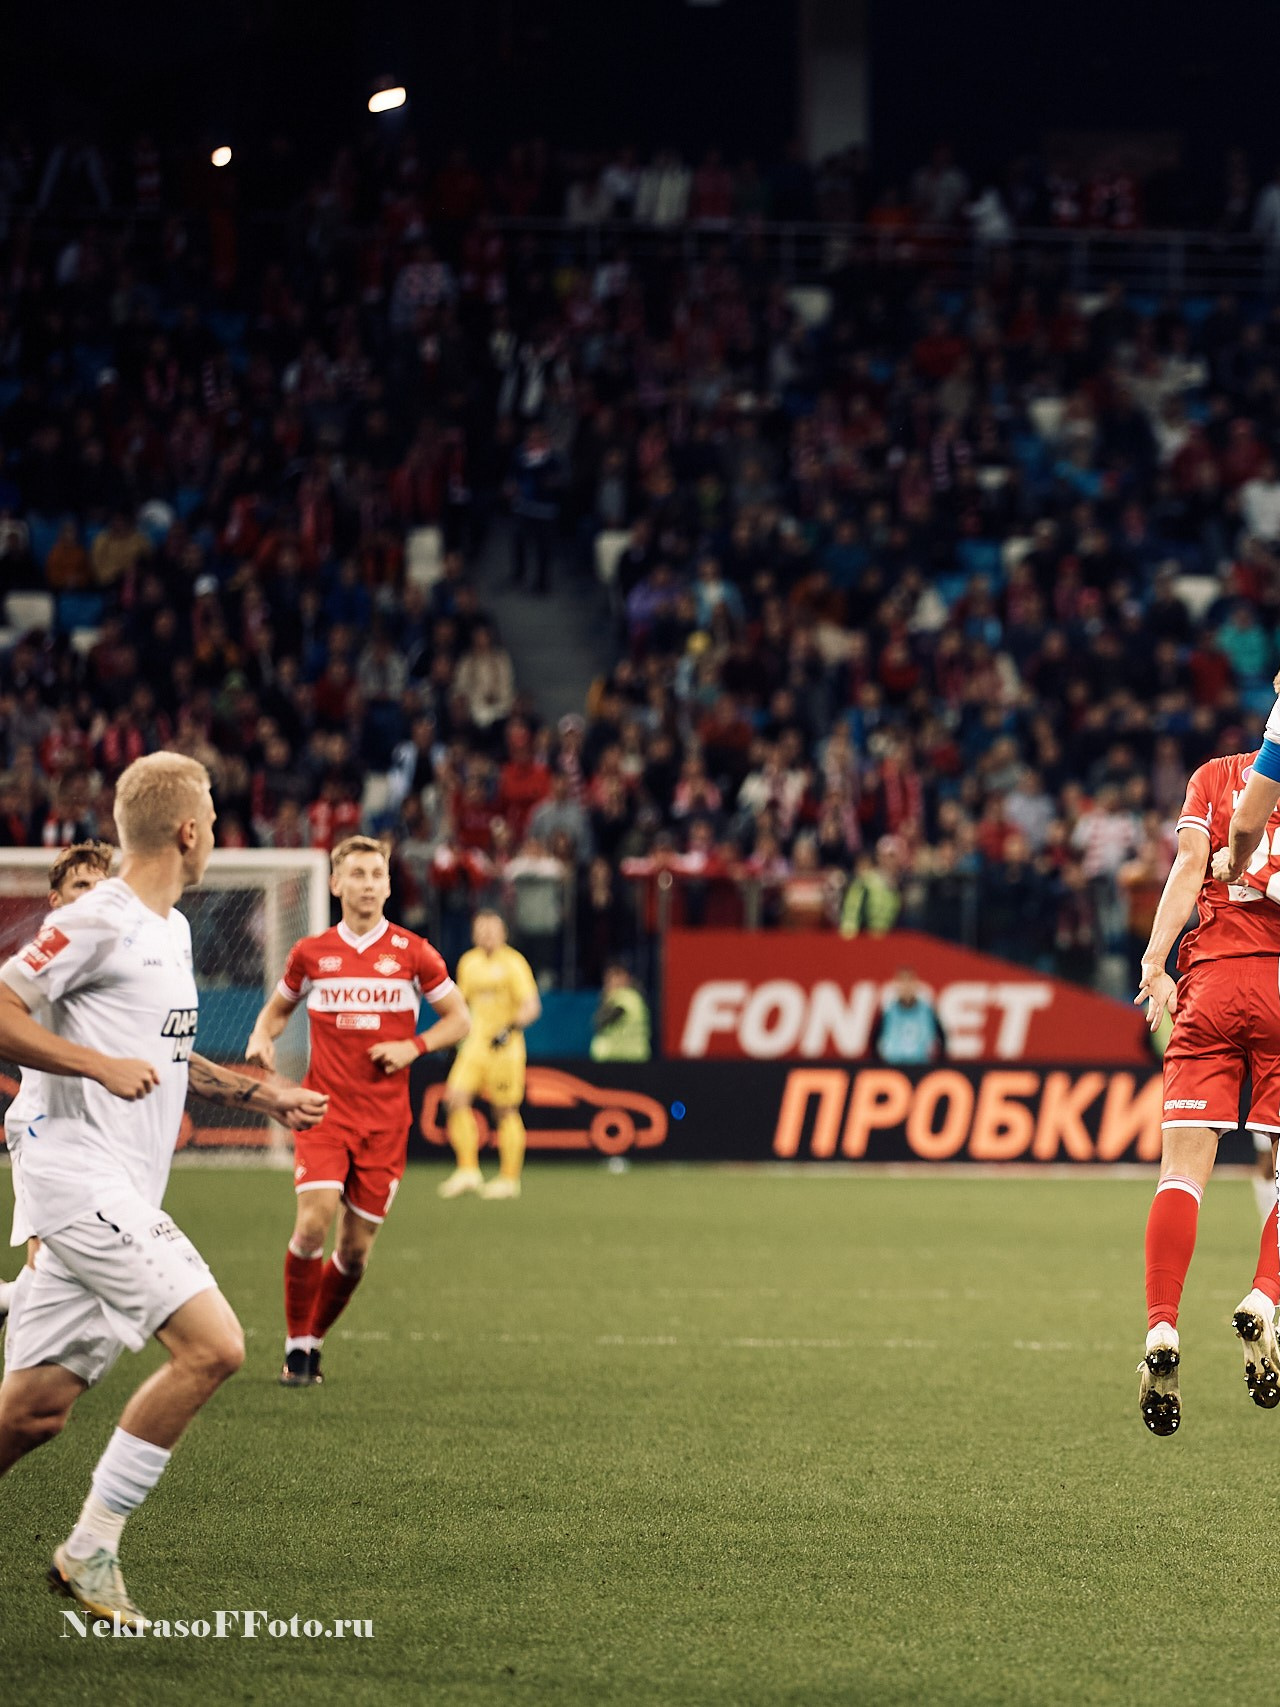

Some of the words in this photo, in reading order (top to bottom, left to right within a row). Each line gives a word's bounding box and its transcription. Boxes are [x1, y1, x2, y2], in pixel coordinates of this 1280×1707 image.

[320, 986, 401, 1006] ЛУКОЙЛ
[161, 1009, 198, 1037] ПАР
[681, 980, 1053, 1058] FONET
[773, 1068, 1163, 1161] ПРОБКИ
[1164, 1099, 1208, 1110] GENESIS
